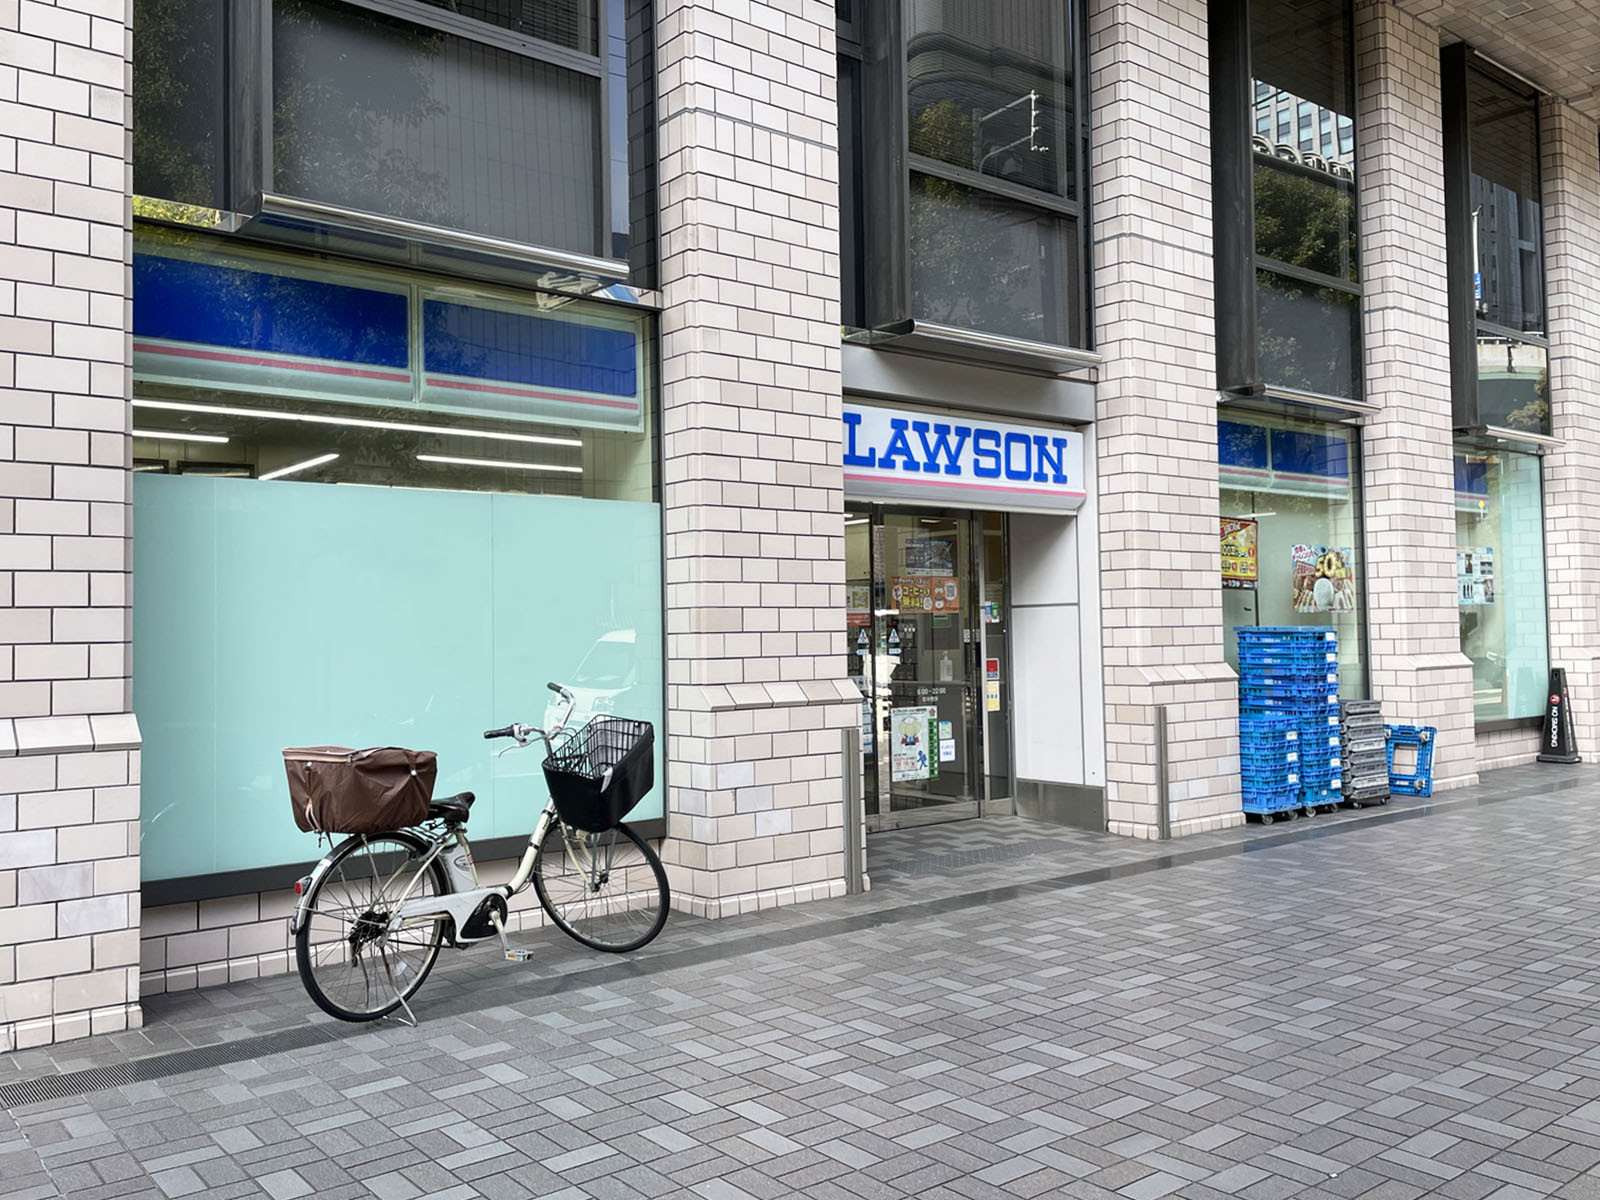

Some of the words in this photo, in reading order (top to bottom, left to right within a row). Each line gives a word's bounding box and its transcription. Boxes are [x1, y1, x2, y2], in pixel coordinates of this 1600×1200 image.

[842, 412, 1067, 484] LAWSON
[1551, 706, 1559, 717] NO
[1551, 717, 1559, 748] SMOKING
